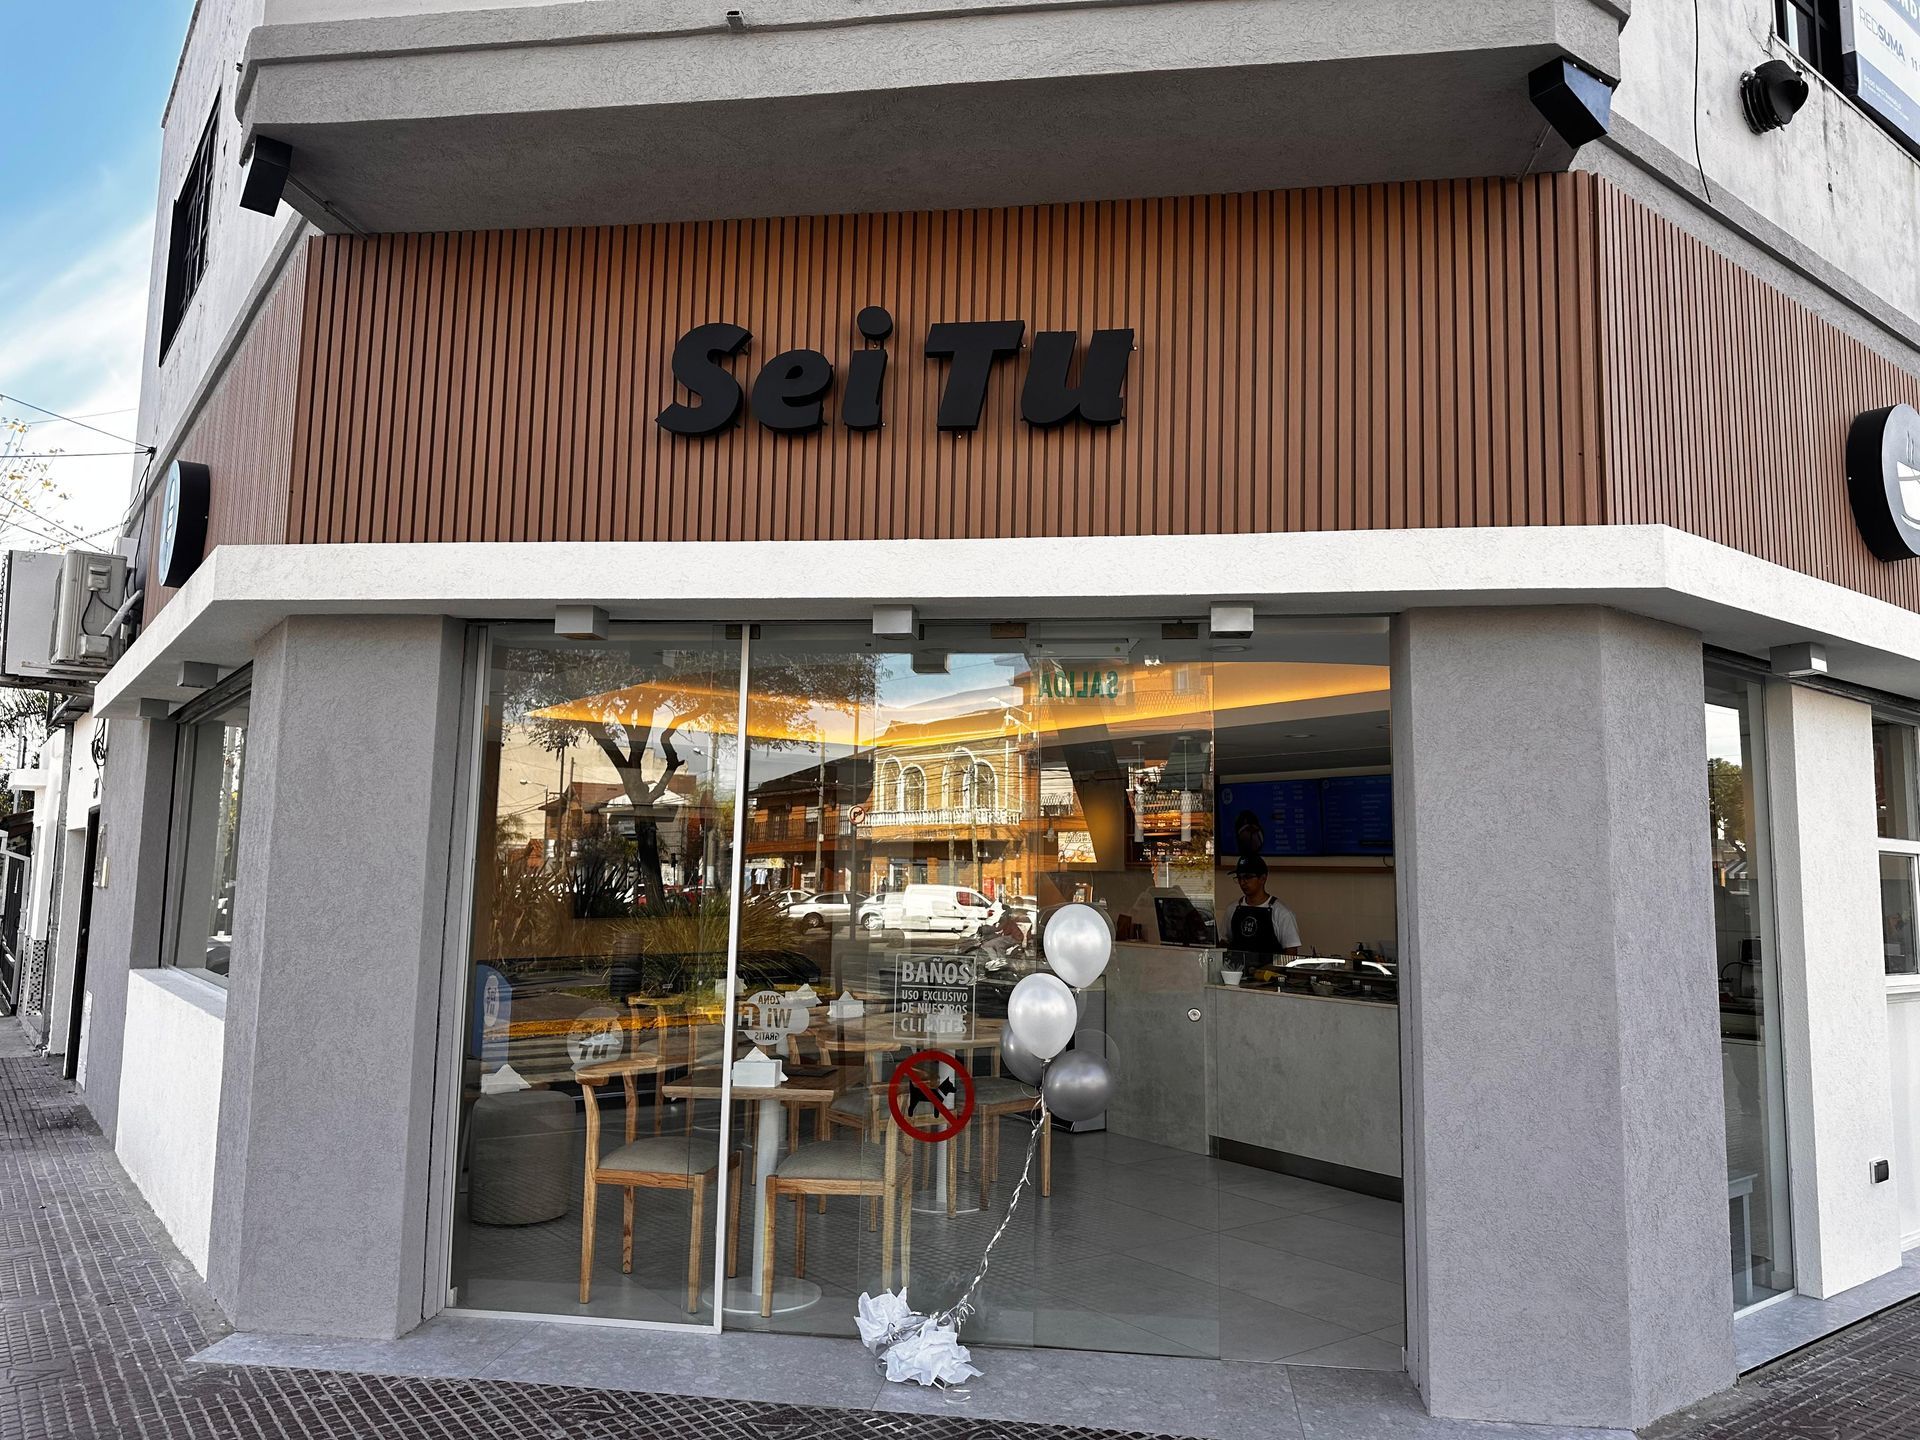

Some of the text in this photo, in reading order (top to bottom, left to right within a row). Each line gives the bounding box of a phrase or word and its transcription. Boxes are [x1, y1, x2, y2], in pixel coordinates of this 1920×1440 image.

[655, 305, 893, 437] Sei
[901, 957, 971, 986] BAÑOS
[901, 989, 969, 1003] USO EXCLUSIVO
[901, 1002, 968, 1016] DE NUESTROS
[900, 1017, 968, 1034] CLIENTES
